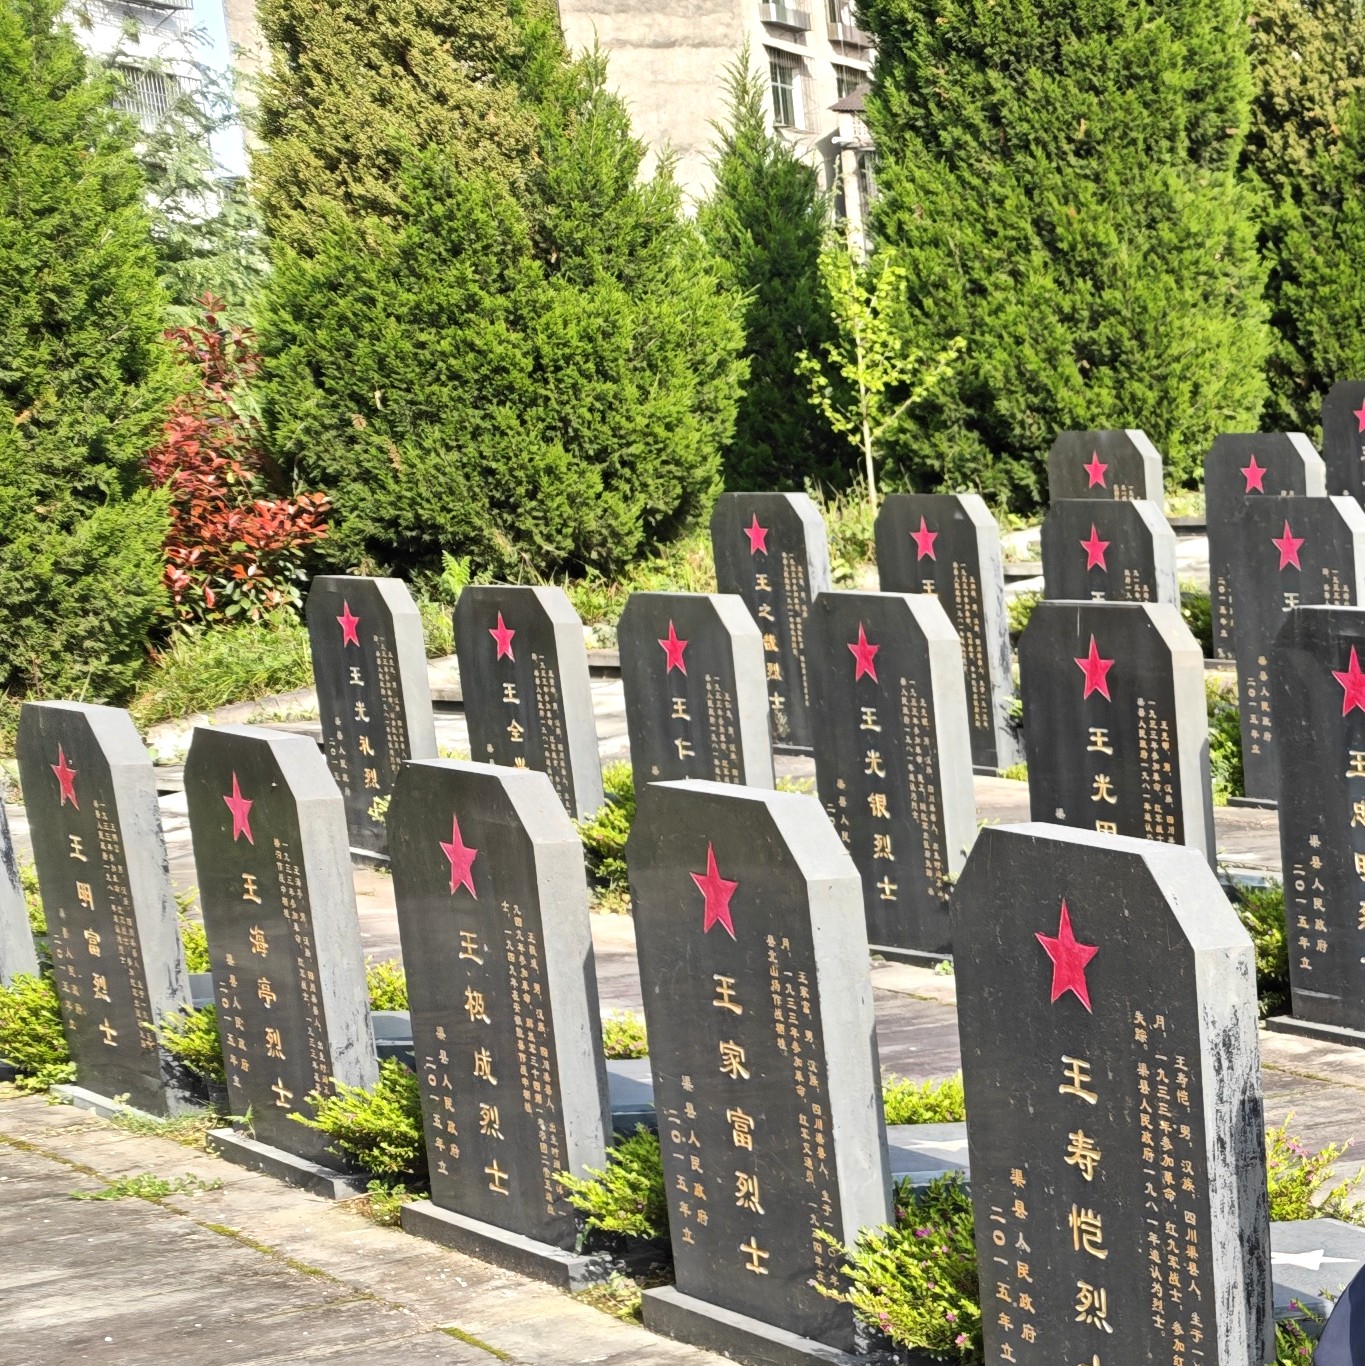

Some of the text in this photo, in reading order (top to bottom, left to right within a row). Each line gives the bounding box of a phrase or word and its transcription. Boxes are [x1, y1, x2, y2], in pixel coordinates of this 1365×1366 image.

[860, 706, 898, 901] 王光银烈士
[1309, 835, 1328, 954] 渠县人民政府
[68, 835, 118, 1047] 王明富烈士
[242, 872, 293, 1108] 王海亭烈士
[435, 1026, 461, 1159] 渠县人民政府
[681, 1075, 708, 1227] 渠县人民政府
[712, 973, 770, 1275] 王家富烈士
[1009, 1168, 1037, 1345] 渠县人民政府
